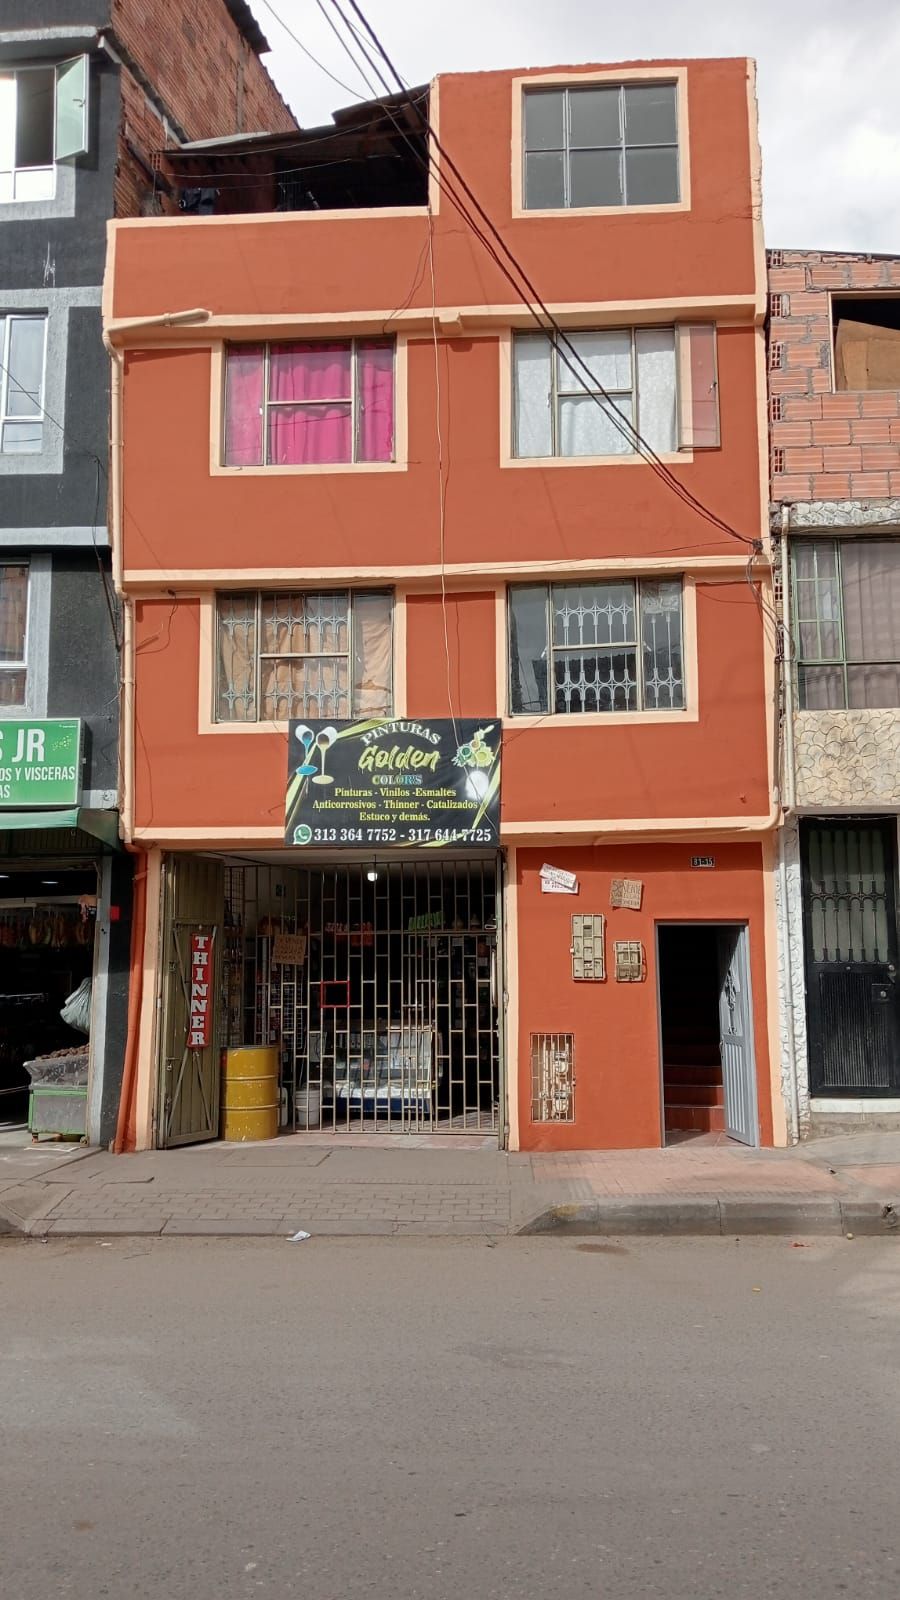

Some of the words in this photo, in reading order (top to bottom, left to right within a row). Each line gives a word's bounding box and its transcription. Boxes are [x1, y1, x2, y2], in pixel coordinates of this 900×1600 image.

[360, 722, 442, 746] PINTURAS
[12, 729, 45, 762] JR
[358, 745, 440, 773] Golden
[15, 768, 21, 780] Y
[25, 766, 75, 780] VISCERAS
[334, 788, 373, 797] Pinturas
[380, 788, 410, 796] Vinilos
[313, 800, 376, 808] Anticorrosivos
[384, 800, 419, 808] Thinner
[427, 800, 478, 808] Catalizados
[359, 812, 390, 821] Estuco
[392, 814, 397, 823] y
[399, 812, 430, 821] demás.
[314, 828, 336, 841] 313
[340, 828, 362, 841] 364
[367, 828, 396, 841] 7752
[409, 828, 430, 841] 317
[434, 828, 457, 841] 644
[461, 828, 491, 841] 7725
[191, 936, 208, 1045] THINNER
